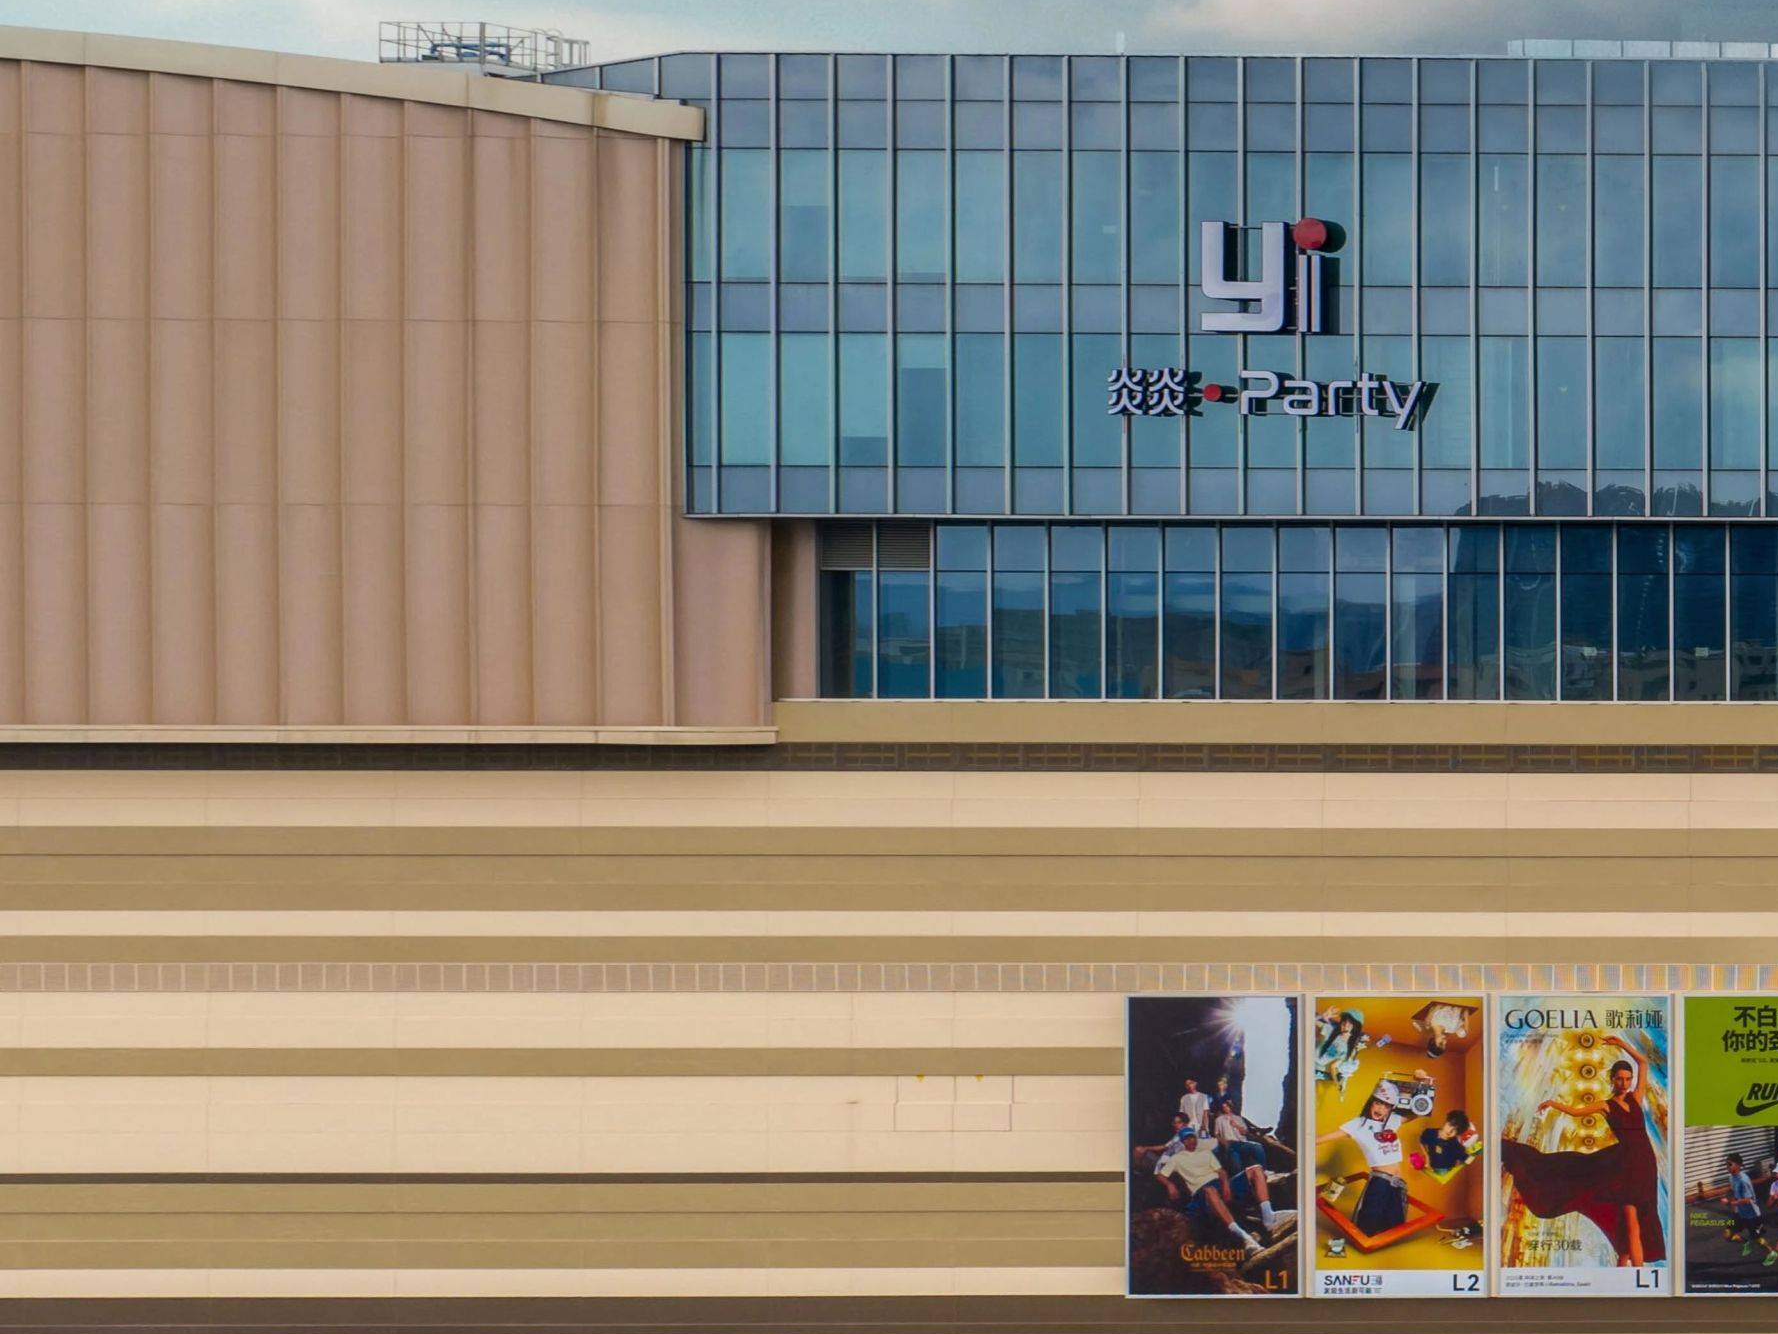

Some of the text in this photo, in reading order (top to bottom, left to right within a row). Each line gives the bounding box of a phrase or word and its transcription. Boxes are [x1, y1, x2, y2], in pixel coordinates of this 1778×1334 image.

[1505, 1009, 1663, 1029] GOELIA 歌莉娅
[1181, 1243, 1246, 1262] Cabbeen
[1265, 1271, 1289, 1289] L1
[1453, 1274, 1480, 1291] L2
[1636, 1271, 1660, 1288] L1
